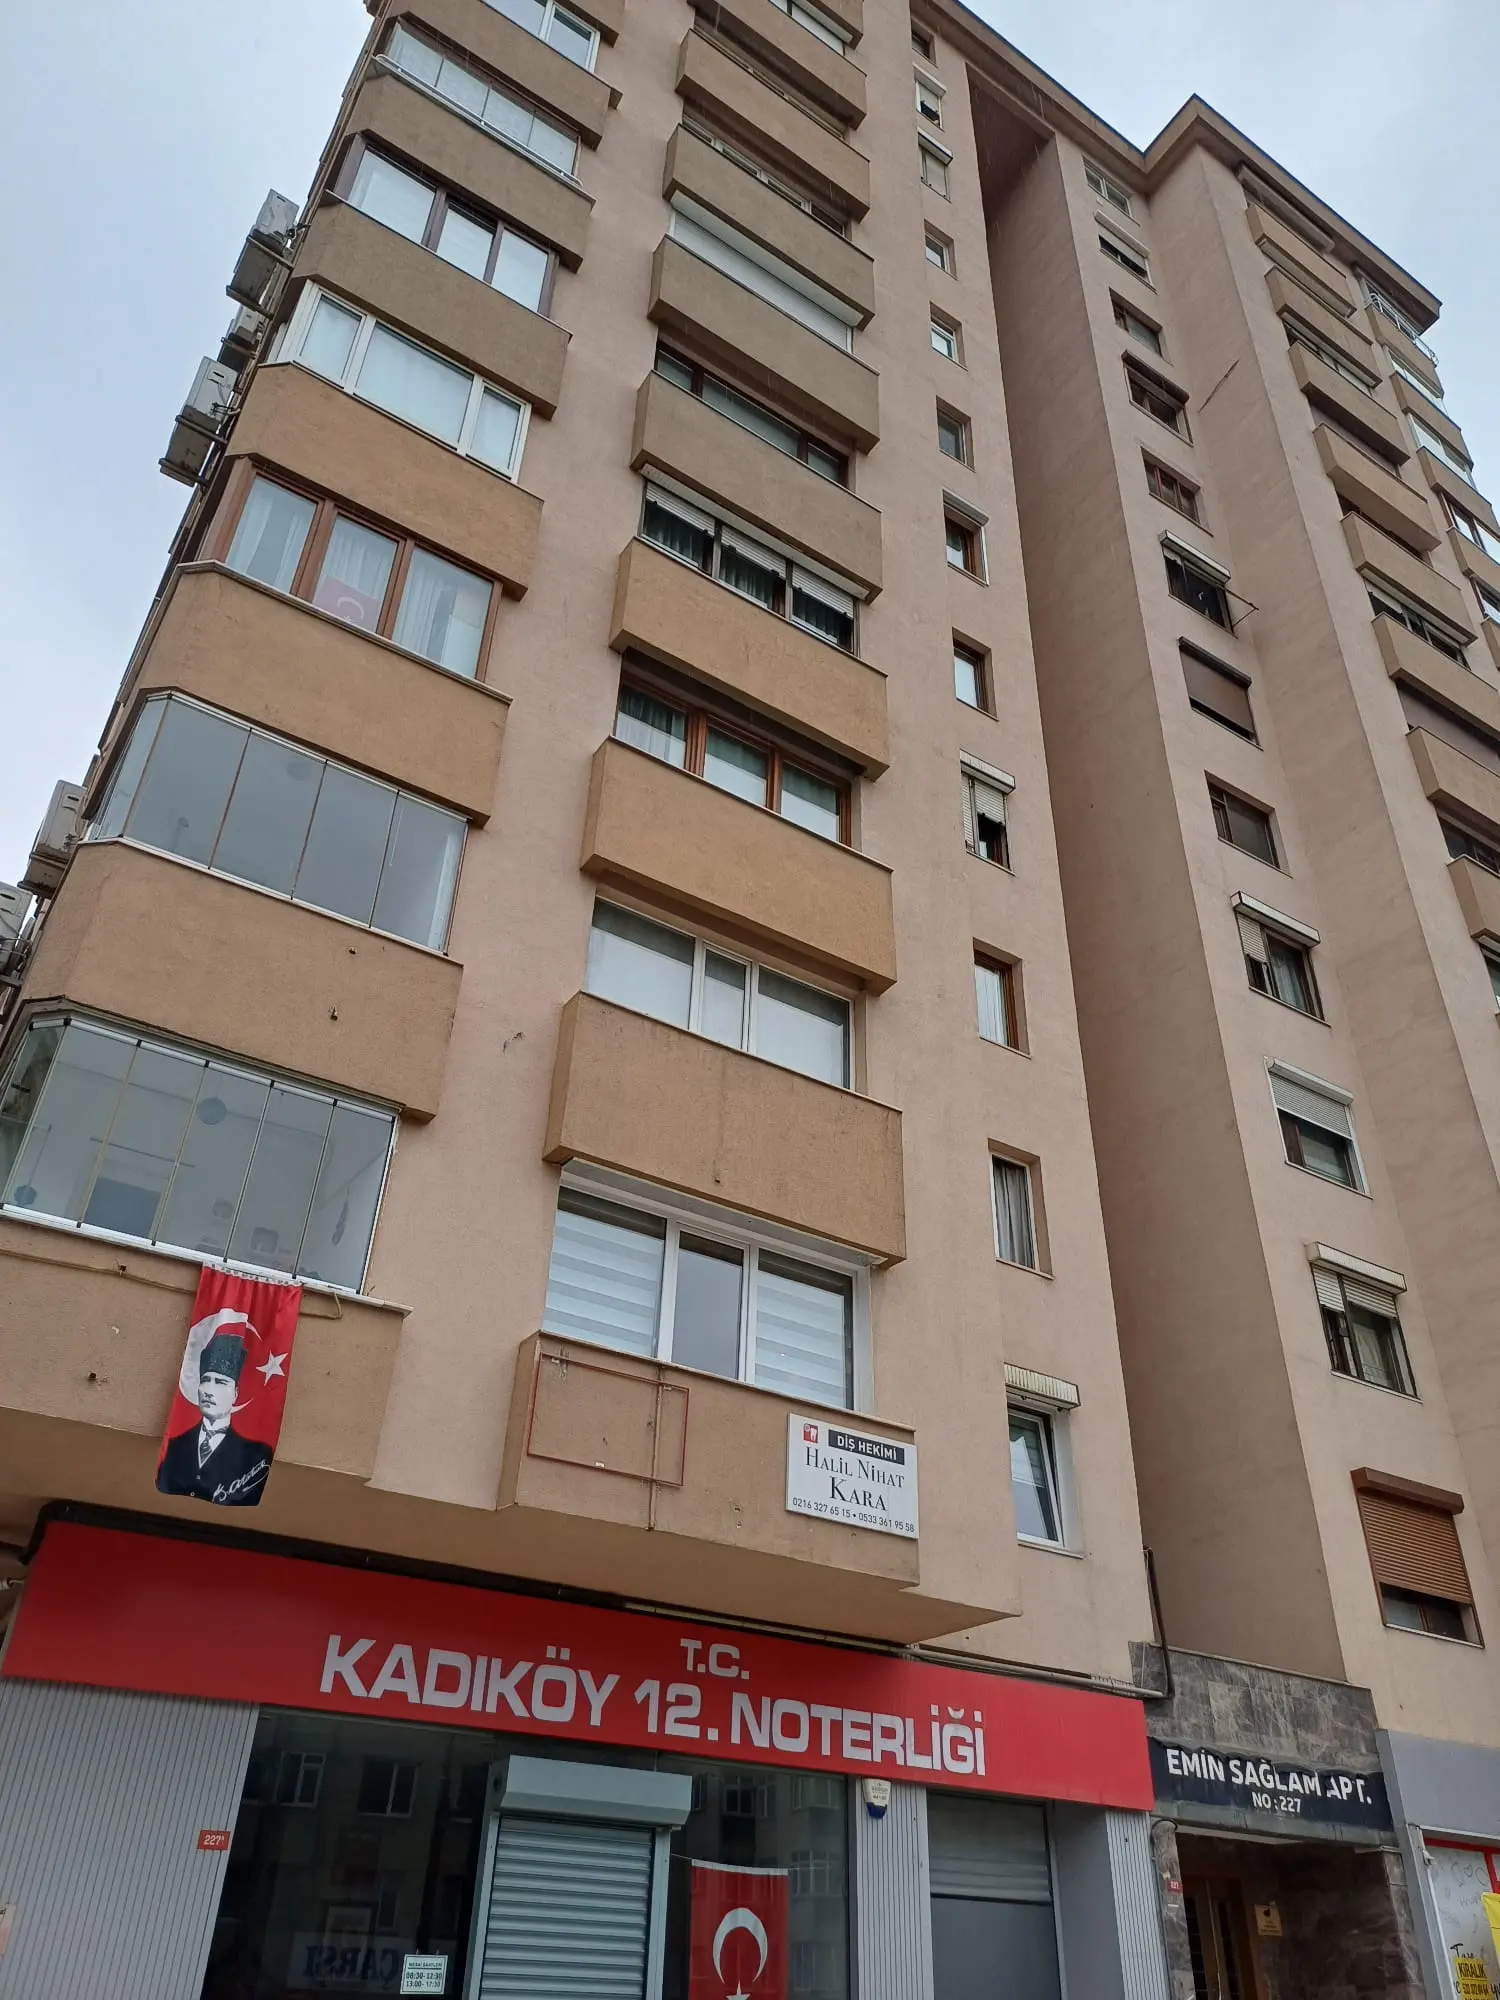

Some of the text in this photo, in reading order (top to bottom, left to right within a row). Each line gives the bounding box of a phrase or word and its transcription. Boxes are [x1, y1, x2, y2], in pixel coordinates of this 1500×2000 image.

[837, 1434, 897, 1460] DİŞ HEKİMİ
[805, 1446, 905, 1488] HALİL NİHAT
[829, 1475, 888, 1511] KARA
[792, 1497, 915, 1533] 0216 327 65 15 0533 361 95 58
[680, 1638, 750, 1680] T.C.
[319, 1634, 986, 1777] KADIKÖY 12. NOTERLİĞİ
[1166, 1748, 1373, 1805] EMİN SAĞLAM APT.
[1280, 1796, 1301, 1813] 227
